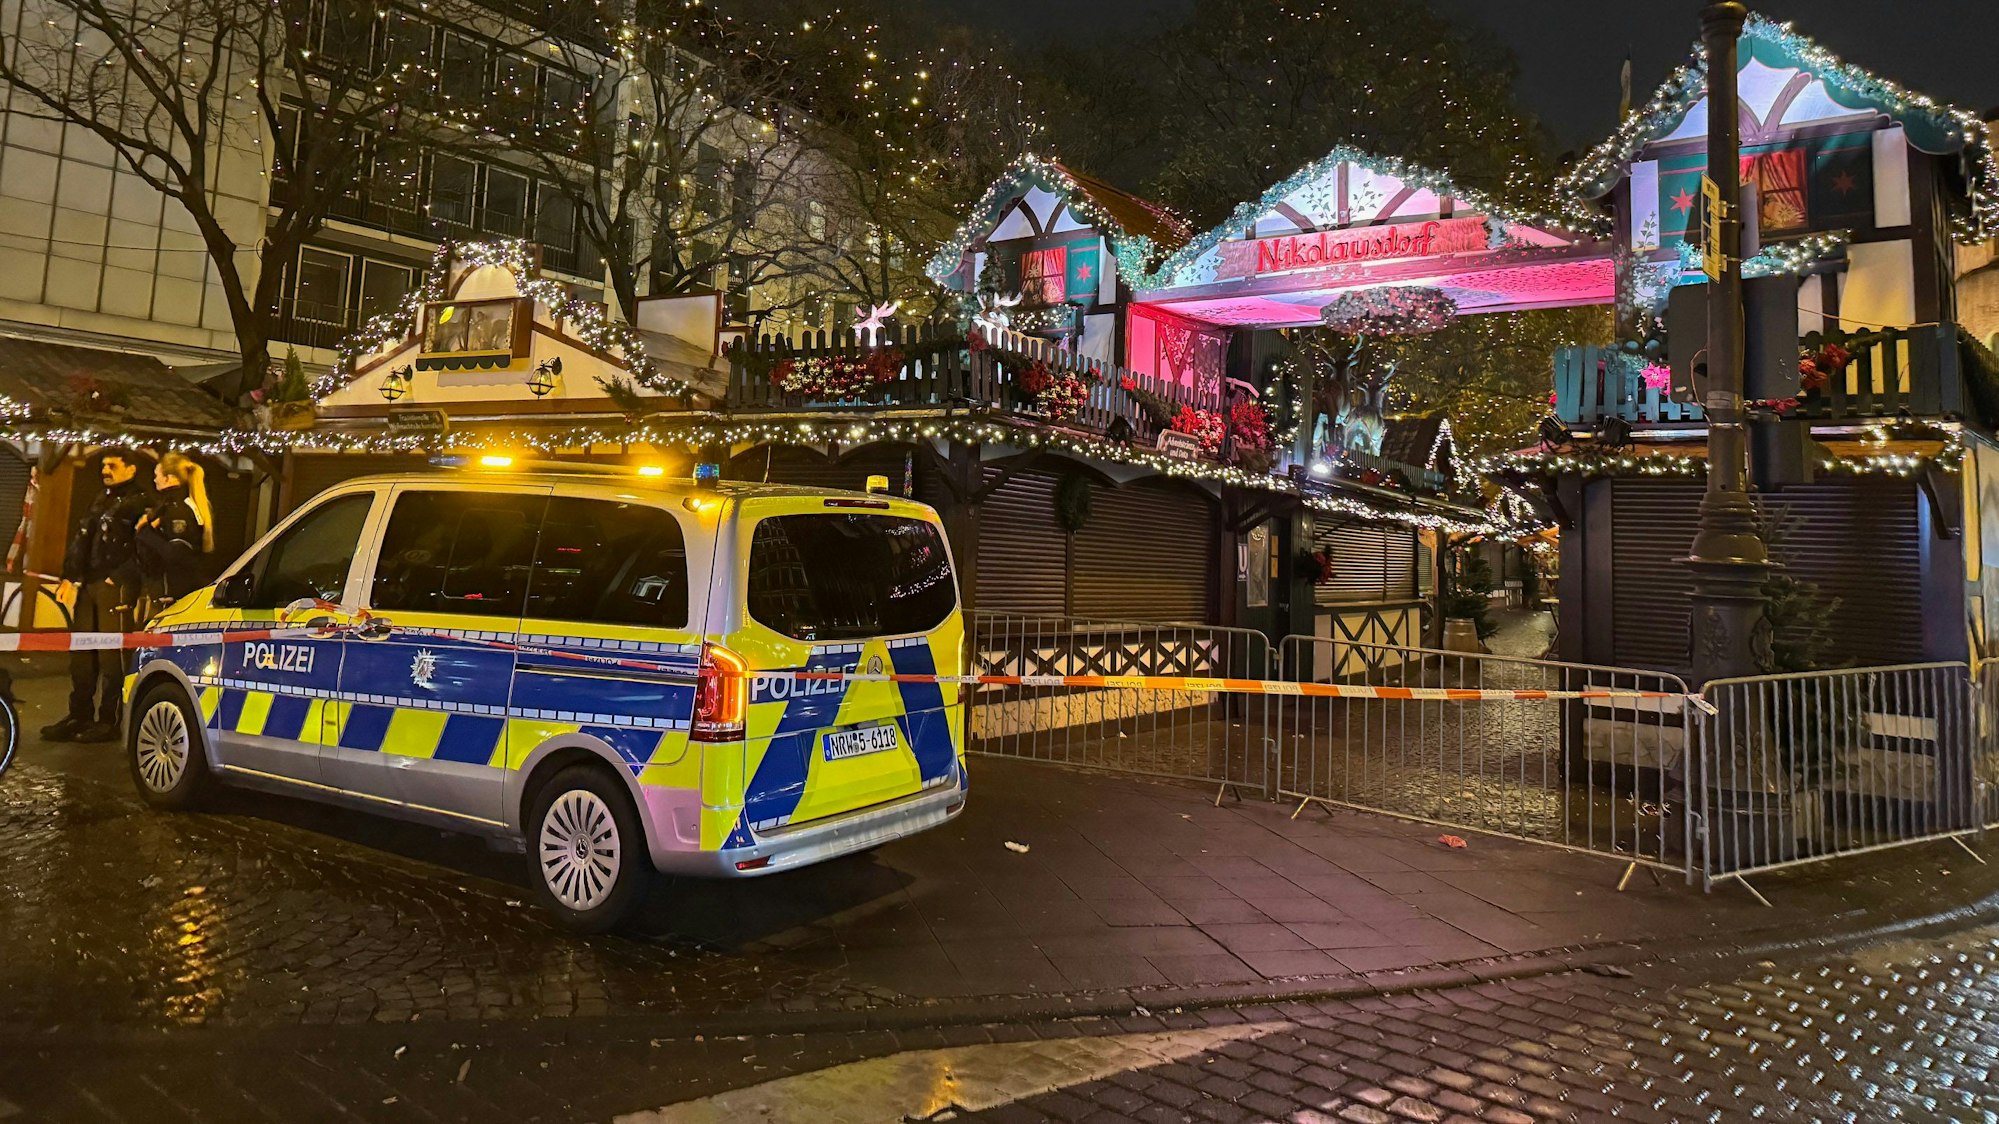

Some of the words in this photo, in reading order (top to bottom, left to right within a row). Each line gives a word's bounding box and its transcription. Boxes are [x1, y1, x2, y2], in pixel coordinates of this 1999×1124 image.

[1257, 221, 1440, 272] Nikolausdorf
[243, 641, 316, 673] POLIZEI
[751, 663, 850, 702] POLIZEI
[858, 728, 896, 751] 5-6118
